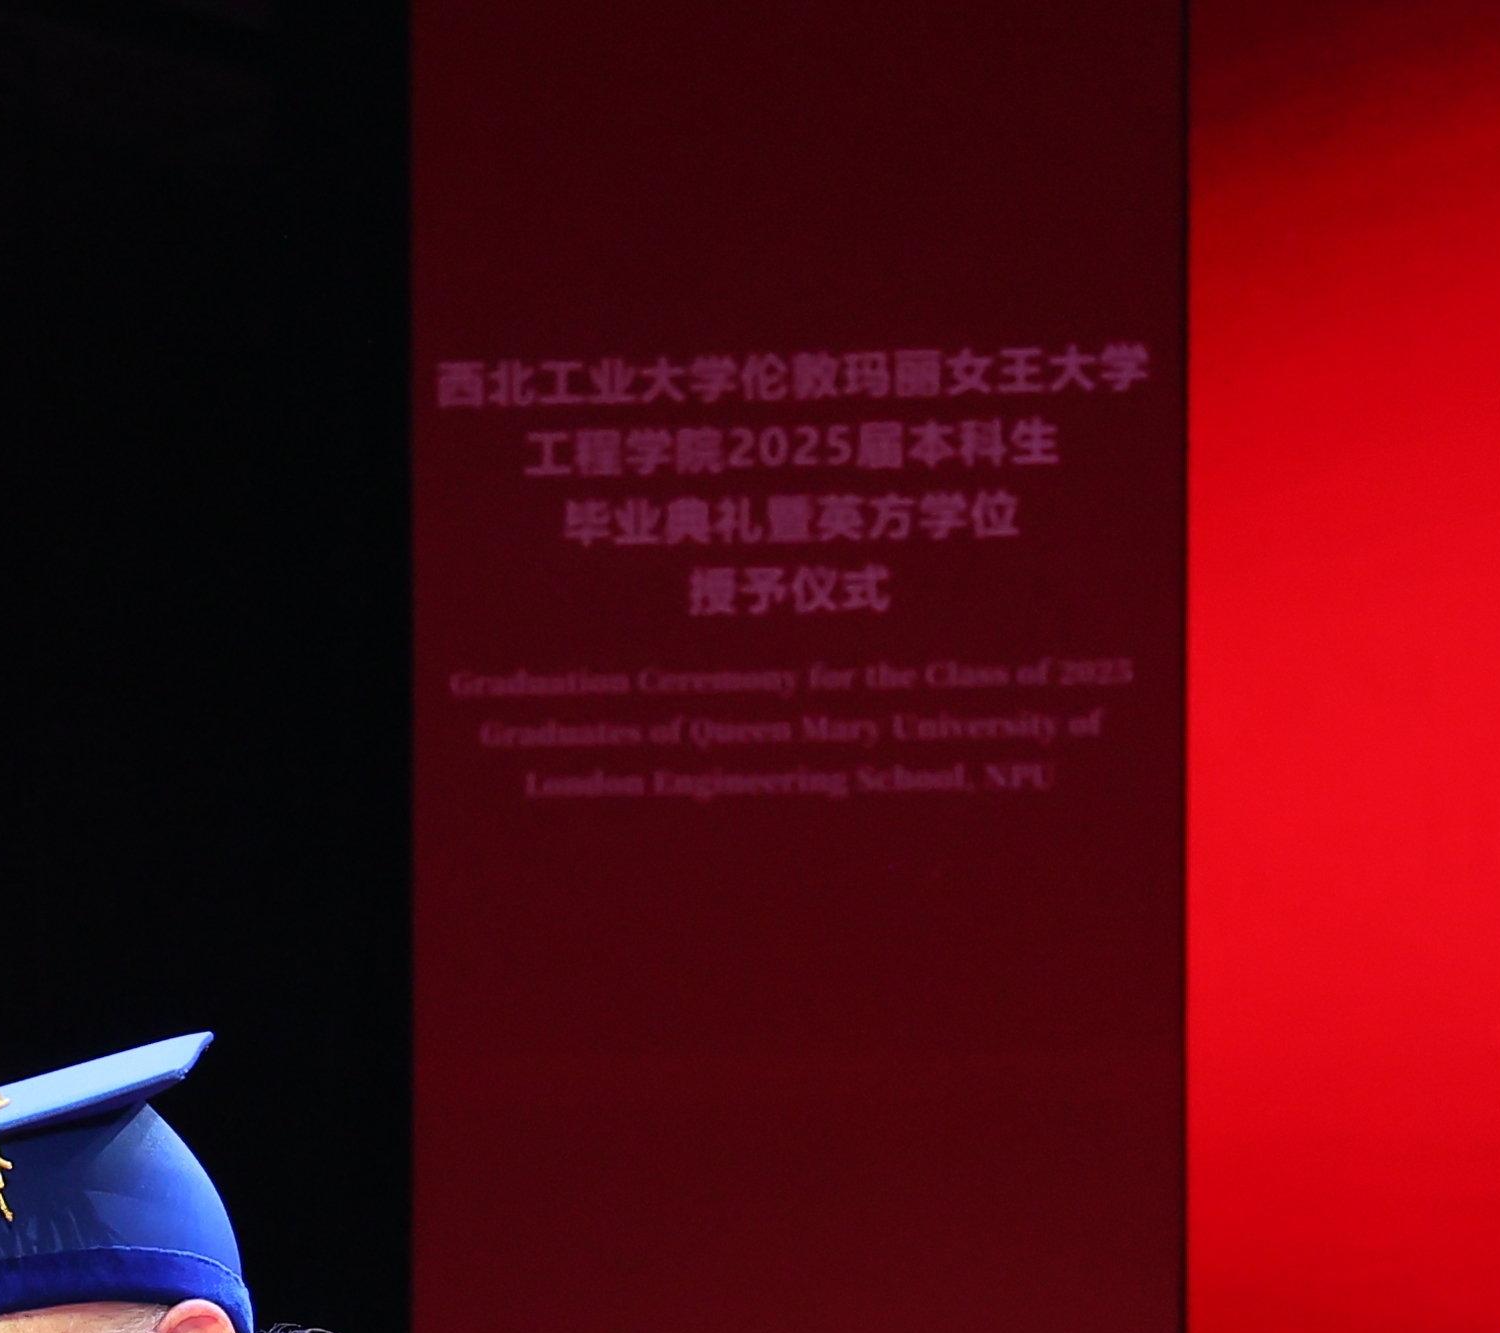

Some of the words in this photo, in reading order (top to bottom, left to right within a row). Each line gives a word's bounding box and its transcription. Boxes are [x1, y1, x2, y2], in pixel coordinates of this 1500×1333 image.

[436, 342, 1149, 408] 西北工业大学伦敦玛丽女王大学
[524, 416, 1060, 478] 工程学院2025届本科生
[563, 488, 1020, 548] 毕业典礼暨英方学位
[688, 563, 891, 616] 授予仪式
[450, 669, 629, 696] Graduation
[637, 669, 796, 697] Ceremony
[808, 662, 856, 690] for
[865, 662, 918, 689] the
[924, 661, 1011, 688] Class
[1015, 658, 1052, 687] of
[1059, 658, 1134, 686] 2025
[480, 718, 643, 747] Graduates
[649, 716, 685, 744] of
[690, 719, 793, 748] Queen
[802, 715, 880, 743] Mary
[893, 712, 1057, 744] University
[1068, 708, 1105, 737] of
[525, 769, 645, 797] London
[653, 767, 849, 801] Engineering
[985, 762, 1050, 790] NPU
